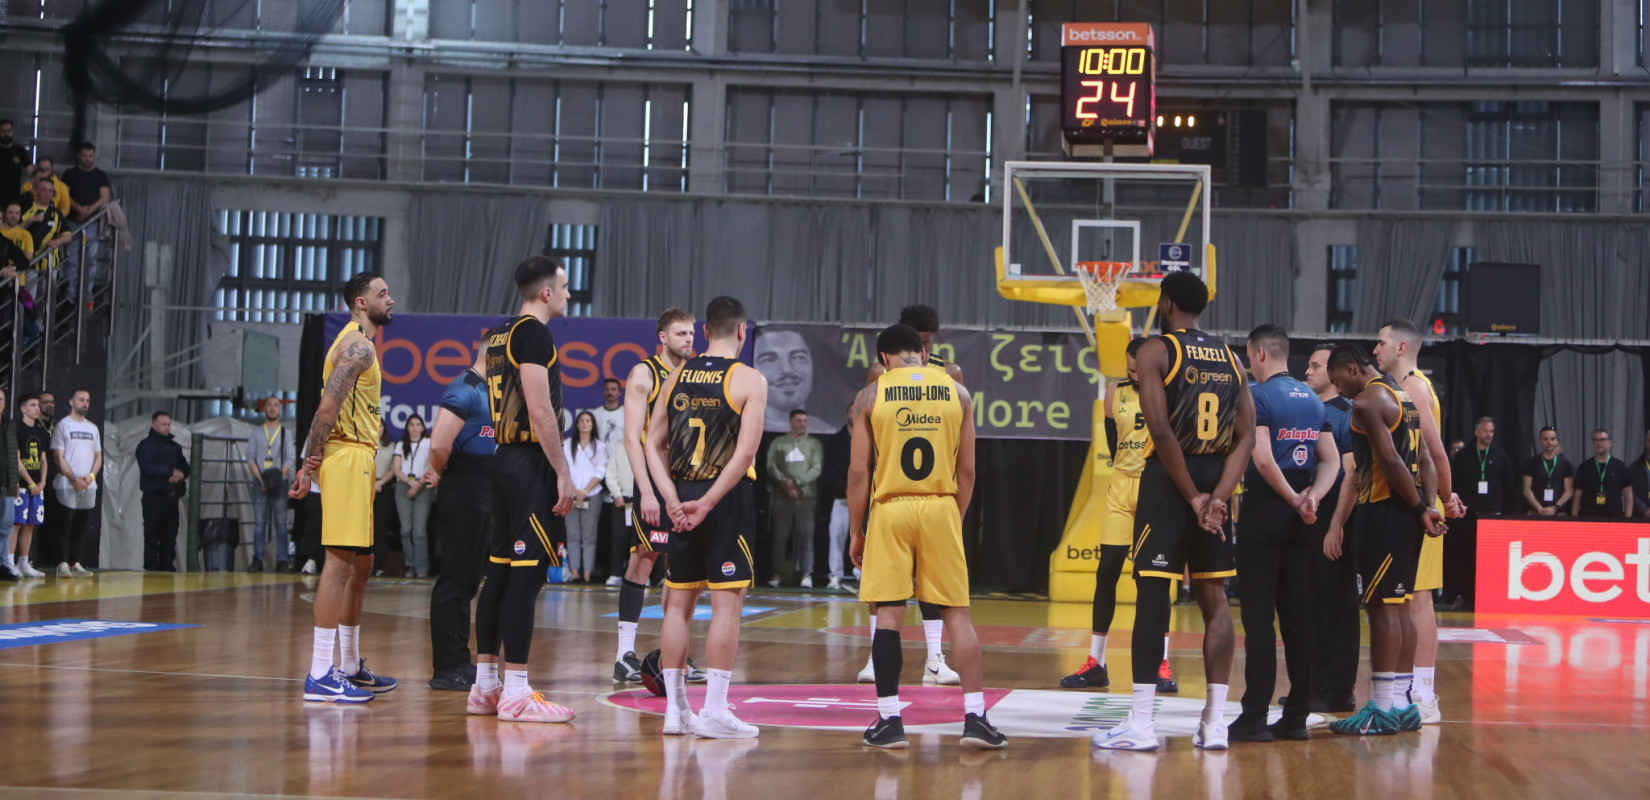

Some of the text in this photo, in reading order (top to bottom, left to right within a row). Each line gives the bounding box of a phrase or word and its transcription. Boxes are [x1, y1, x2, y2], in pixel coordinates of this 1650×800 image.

[1069, 28, 1136, 40] betsson
[1079, 48, 1145, 75] 10:00
[1075, 80, 1136, 118] 24
[1181, 138, 1211, 149] GUEST
[1186, 345, 1227, 362] FEAZELL
[680, 369, 724, 383] FLIONIS
[1200, 370, 1233, 384] green
[884, 385, 951, 402] MITROU-LONG
[691, 397, 720, 410] green
[897, 409, 941, 425] Midea
[1197, 392, 1219, 440] 8
[688, 418, 706, 466] 7
[900, 436, 935, 481] 0
